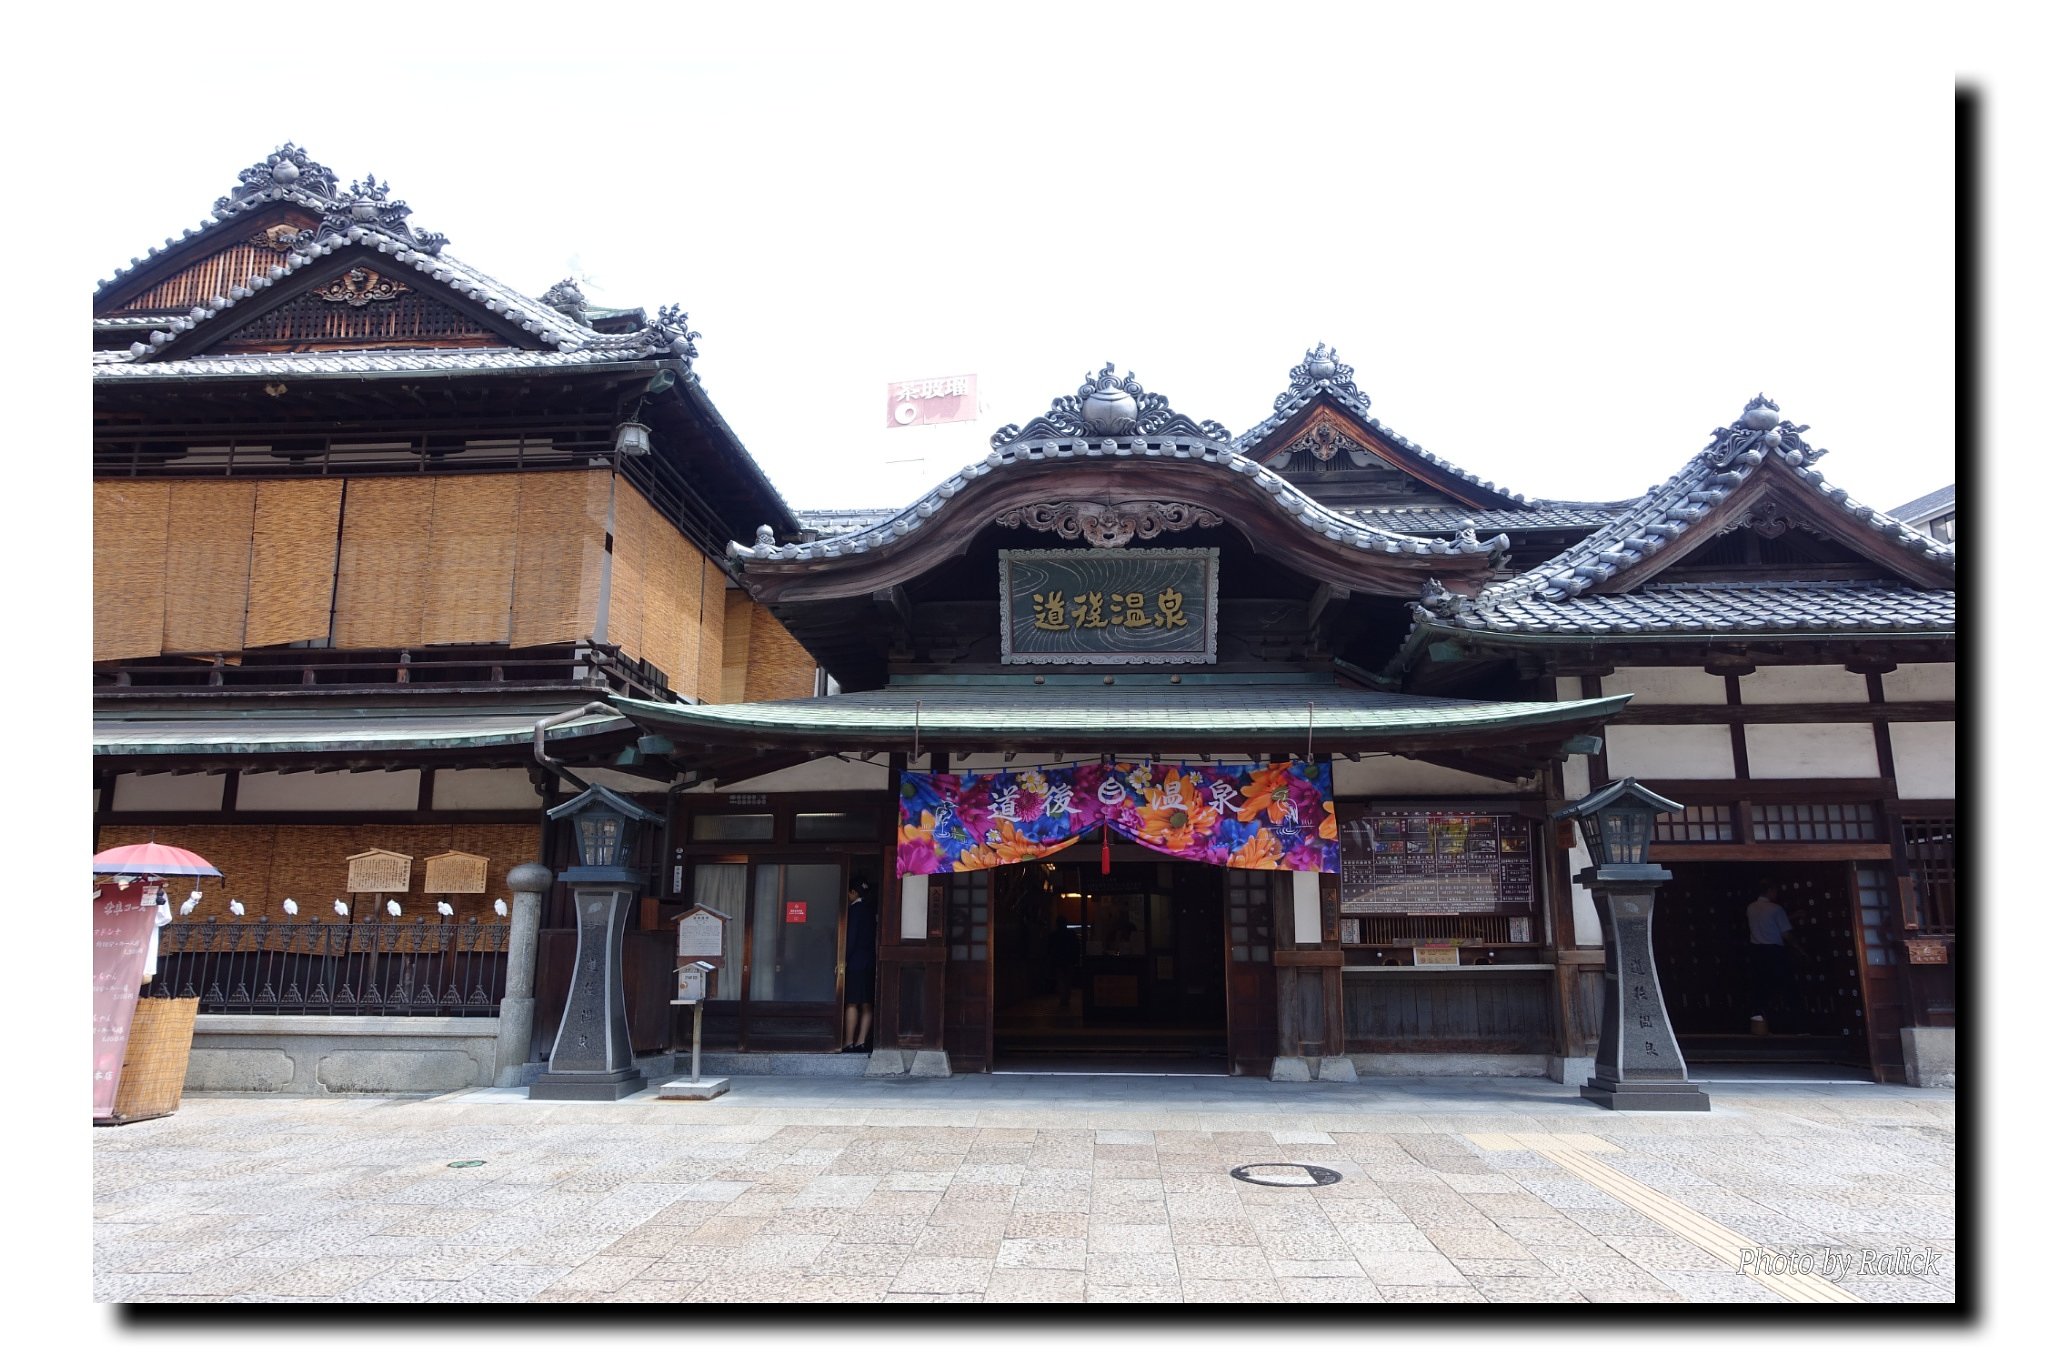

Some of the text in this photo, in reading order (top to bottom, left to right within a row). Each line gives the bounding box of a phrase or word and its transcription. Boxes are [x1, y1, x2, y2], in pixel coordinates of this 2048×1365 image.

[1032, 586, 1188, 631] 道後温泉
[987, 778, 1245, 822] 道後 温泉
[578, 956, 600, 1049] 道後温泉
[1629, 957, 1660, 1058] 道後温泉
